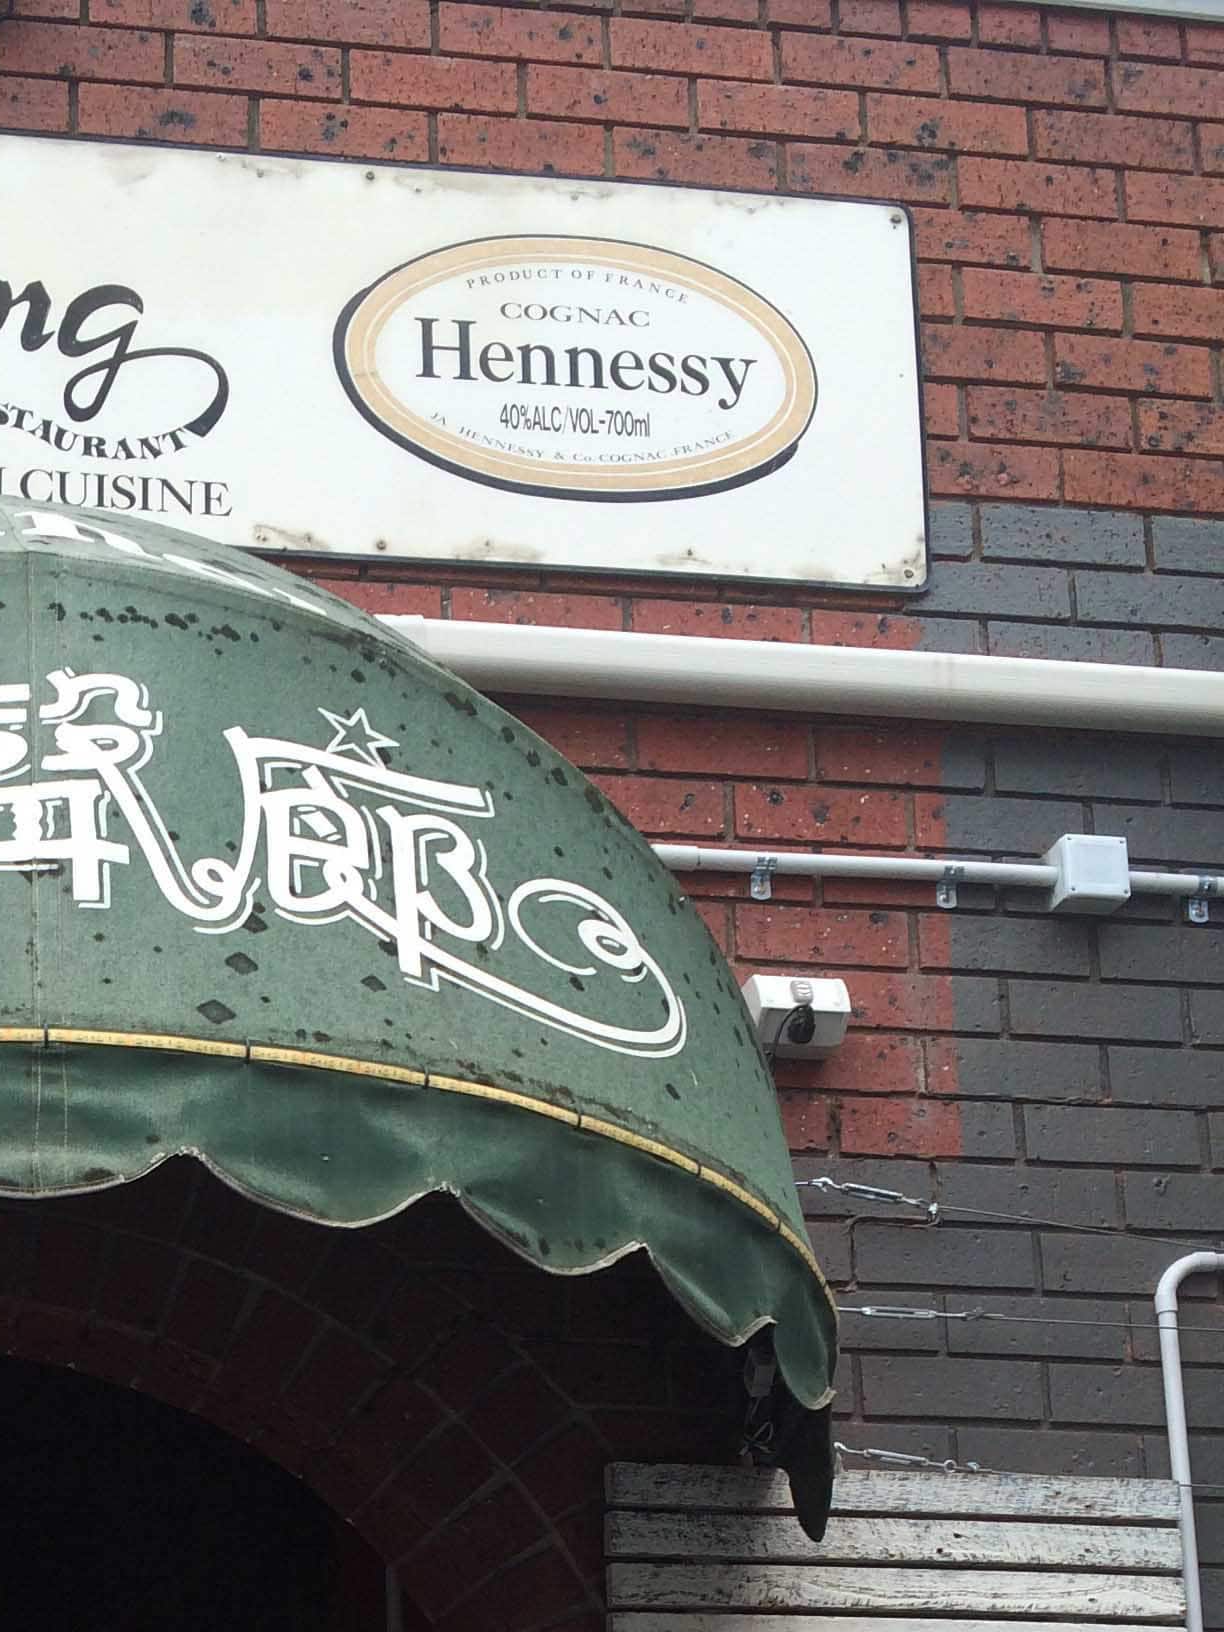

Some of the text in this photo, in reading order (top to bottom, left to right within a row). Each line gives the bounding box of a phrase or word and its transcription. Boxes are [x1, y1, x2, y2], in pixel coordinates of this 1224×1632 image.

[466, 268, 689, 304] PRODUCT OF FRANCE
[499, 301, 651, 328] COGNAC
[414, 316, 758, 411] Hennessy
[458, 425, 545, 459] HENNESSY
[19, 468, 233, 518] CUISINE
